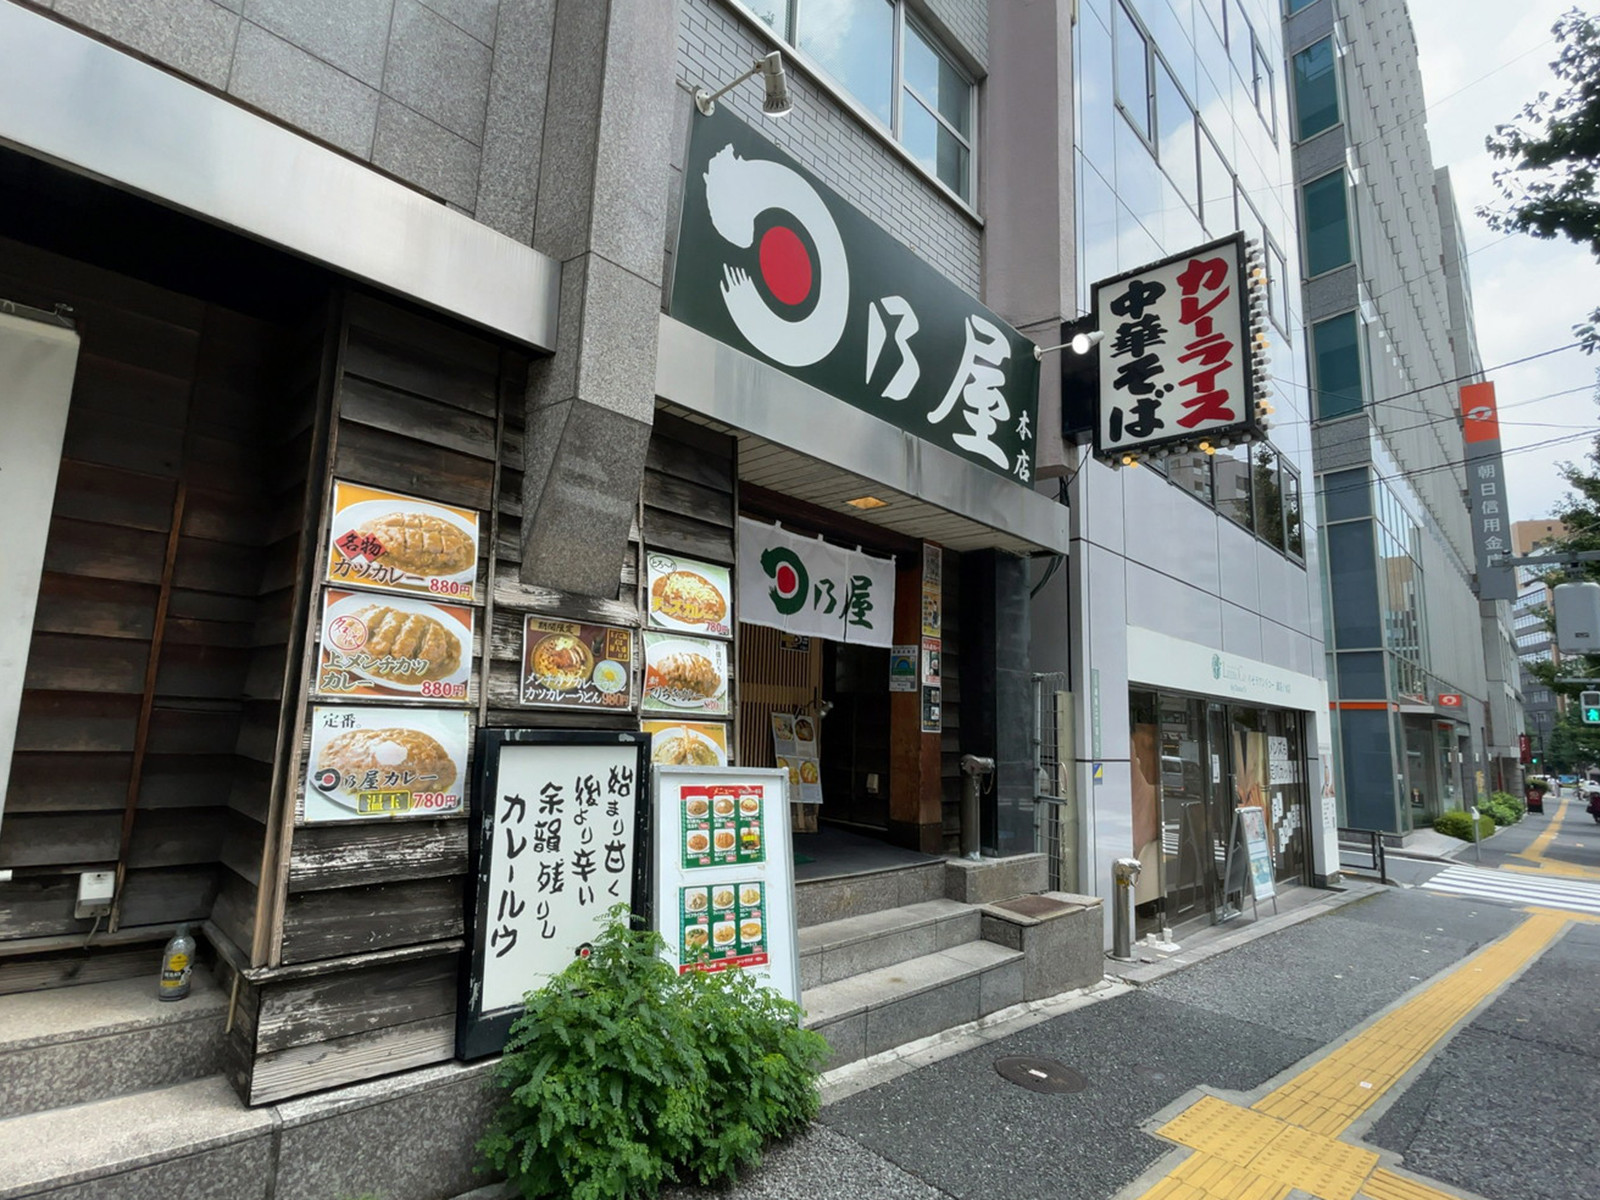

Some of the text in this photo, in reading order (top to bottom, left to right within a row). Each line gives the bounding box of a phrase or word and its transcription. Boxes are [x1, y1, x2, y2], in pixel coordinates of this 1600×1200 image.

[1176, 257, 1235, 429] カレーライス
[1109, 279, 1175, 443] 中華そば
[1013, 410, 1032, 482] 本店
[341, 533, 382, 558] 名物
[332, 558, 425, 584] カツカレー
[428, 578, 471, 596] 880円
[324, 651, 428, 676] 上メンチカツ
[321, 671, 375, 692] カレー
[420, 681, 466, 698] 880円
[525, 686, 602, 704] カツカレーうどん
[412, 792, 458, 809] 780円
[571, 774, 600, 906] 後より辛い
[605, 765, 634, 898] 始まり甘く
[491, 793, 528, 958] カレールウ
